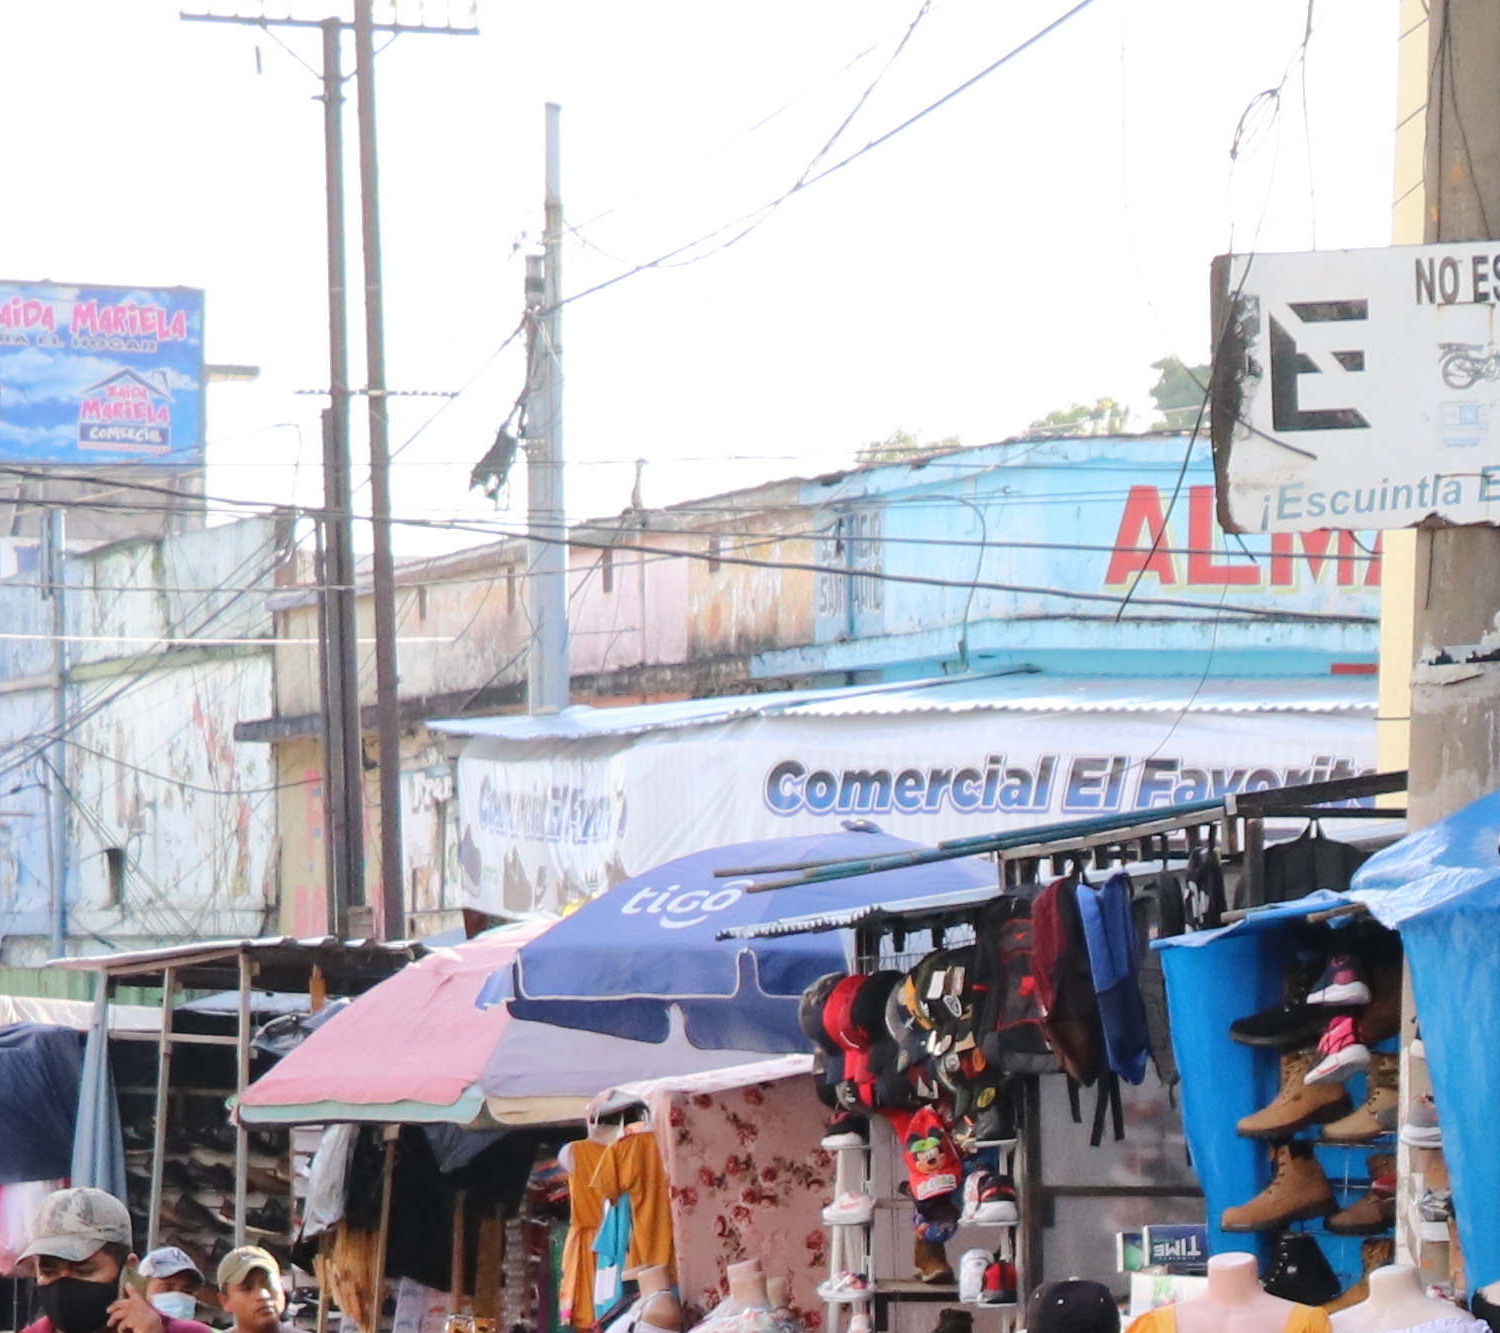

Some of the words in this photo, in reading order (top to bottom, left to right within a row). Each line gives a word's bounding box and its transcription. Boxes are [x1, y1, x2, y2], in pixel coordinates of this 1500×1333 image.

[1415, 256, 1461, 304] NO
[38, 335, 64, 348] EL
[73, 336, 158, 352] HOGAR
[70, 300, 187, 342] MARIELA
[82, 398, 169, 423] MARIELA
[1260, 472, 1462, 529] ¡Escuintla
[765, 753, 1056, 817] Comercial
[1062, 755, 1128, 814] El
[621, 879, 754, 928] tigo
[1153, 1235, 1202, 1257] TIME
